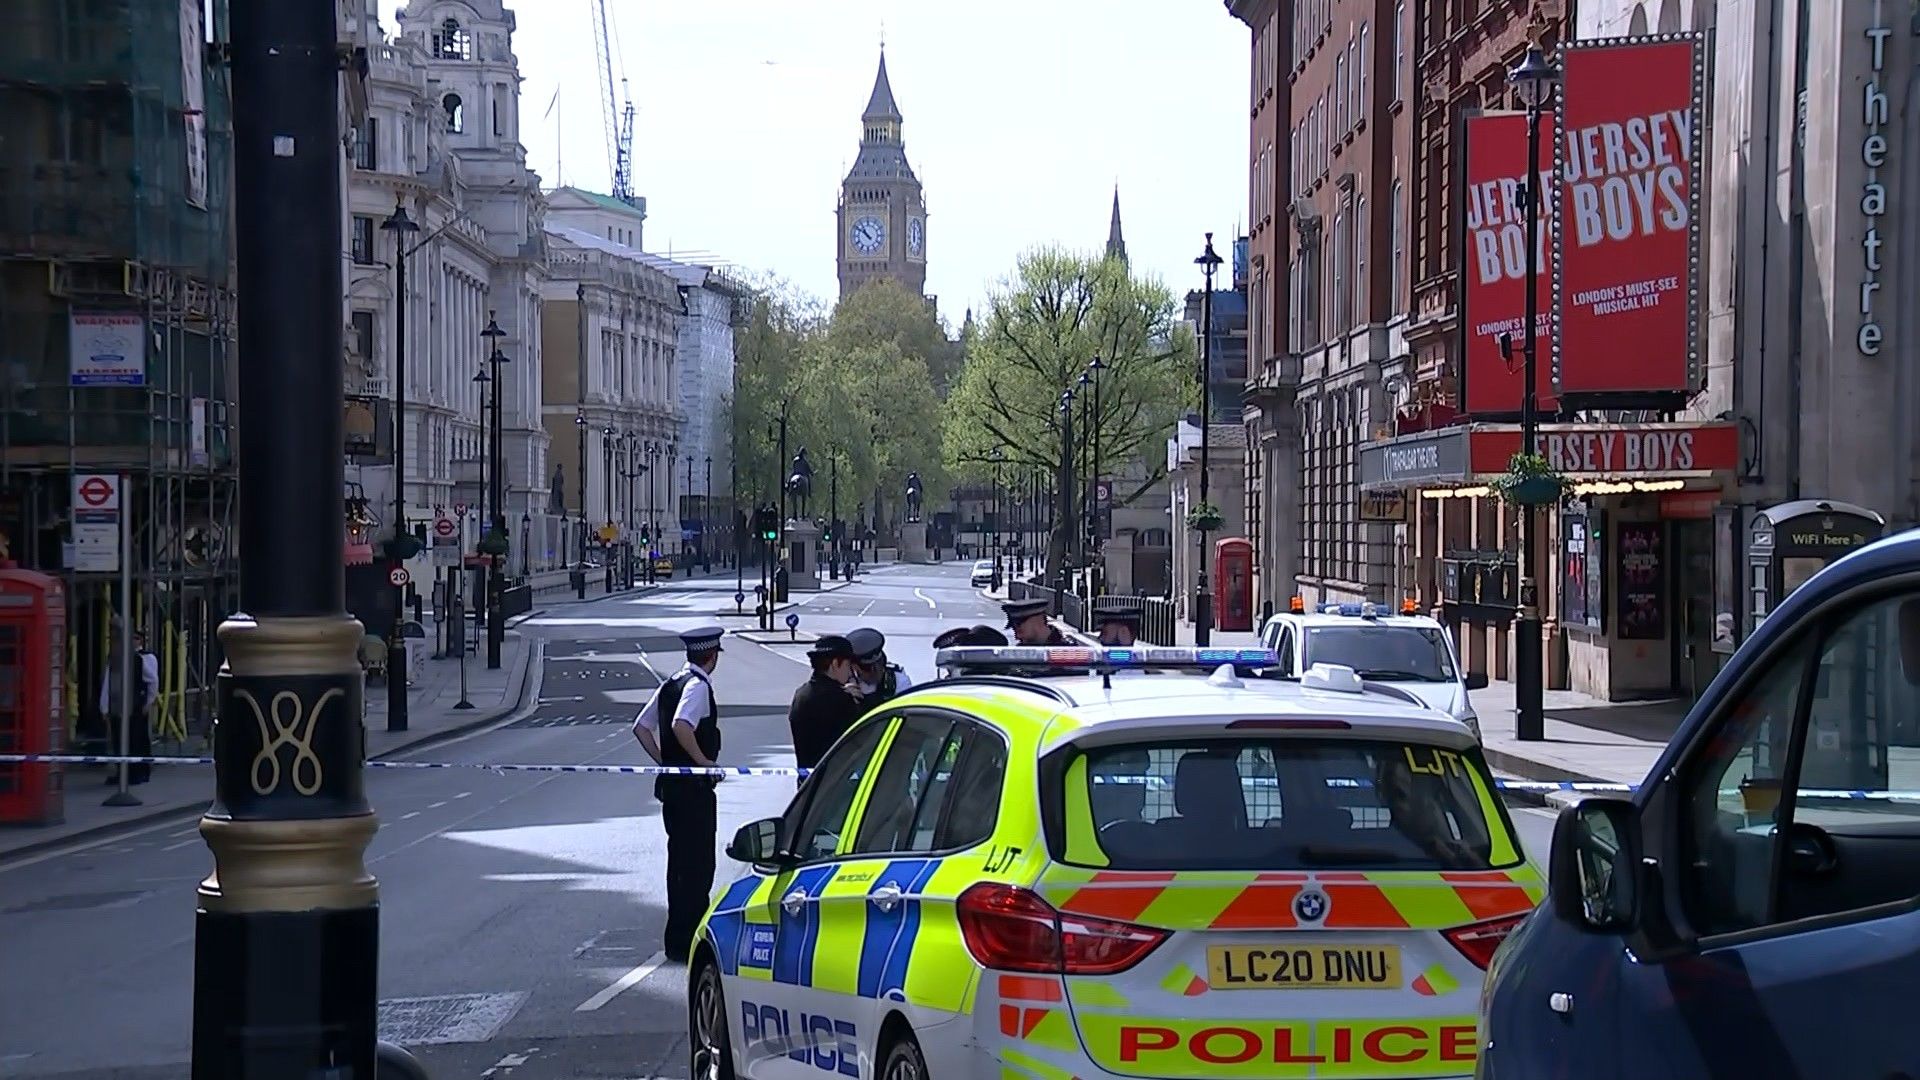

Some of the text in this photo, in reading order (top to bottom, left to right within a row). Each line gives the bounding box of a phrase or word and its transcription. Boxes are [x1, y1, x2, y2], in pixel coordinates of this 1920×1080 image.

[1563, 108, 1692, 183] JERSEY
[1573, 166, 1688, 247] BOYS
[1857, 28, 1892, 355] Theatre
[1572, 276, 1679, 306] LONDON'S MUST-SEE
[1593, 293, 1660, 316] MUSICAL HIT
[1476, 317, 1520, 336] LONDON'S
[1534, 431, 1694, 471] ERSEY BOYS
[1792, 534, 1850, 545] WiFi here
[392, 572, 406, 582] 20
[1403, 745, 1460, 778] LJT
[982, 844, 1023, 875] LJT
[1224, 950, 1387, 983] LC20 DNU
[742, 1000, 860, 1079] POLICE
[1119, 1026, 1477, 1064] POLICE
